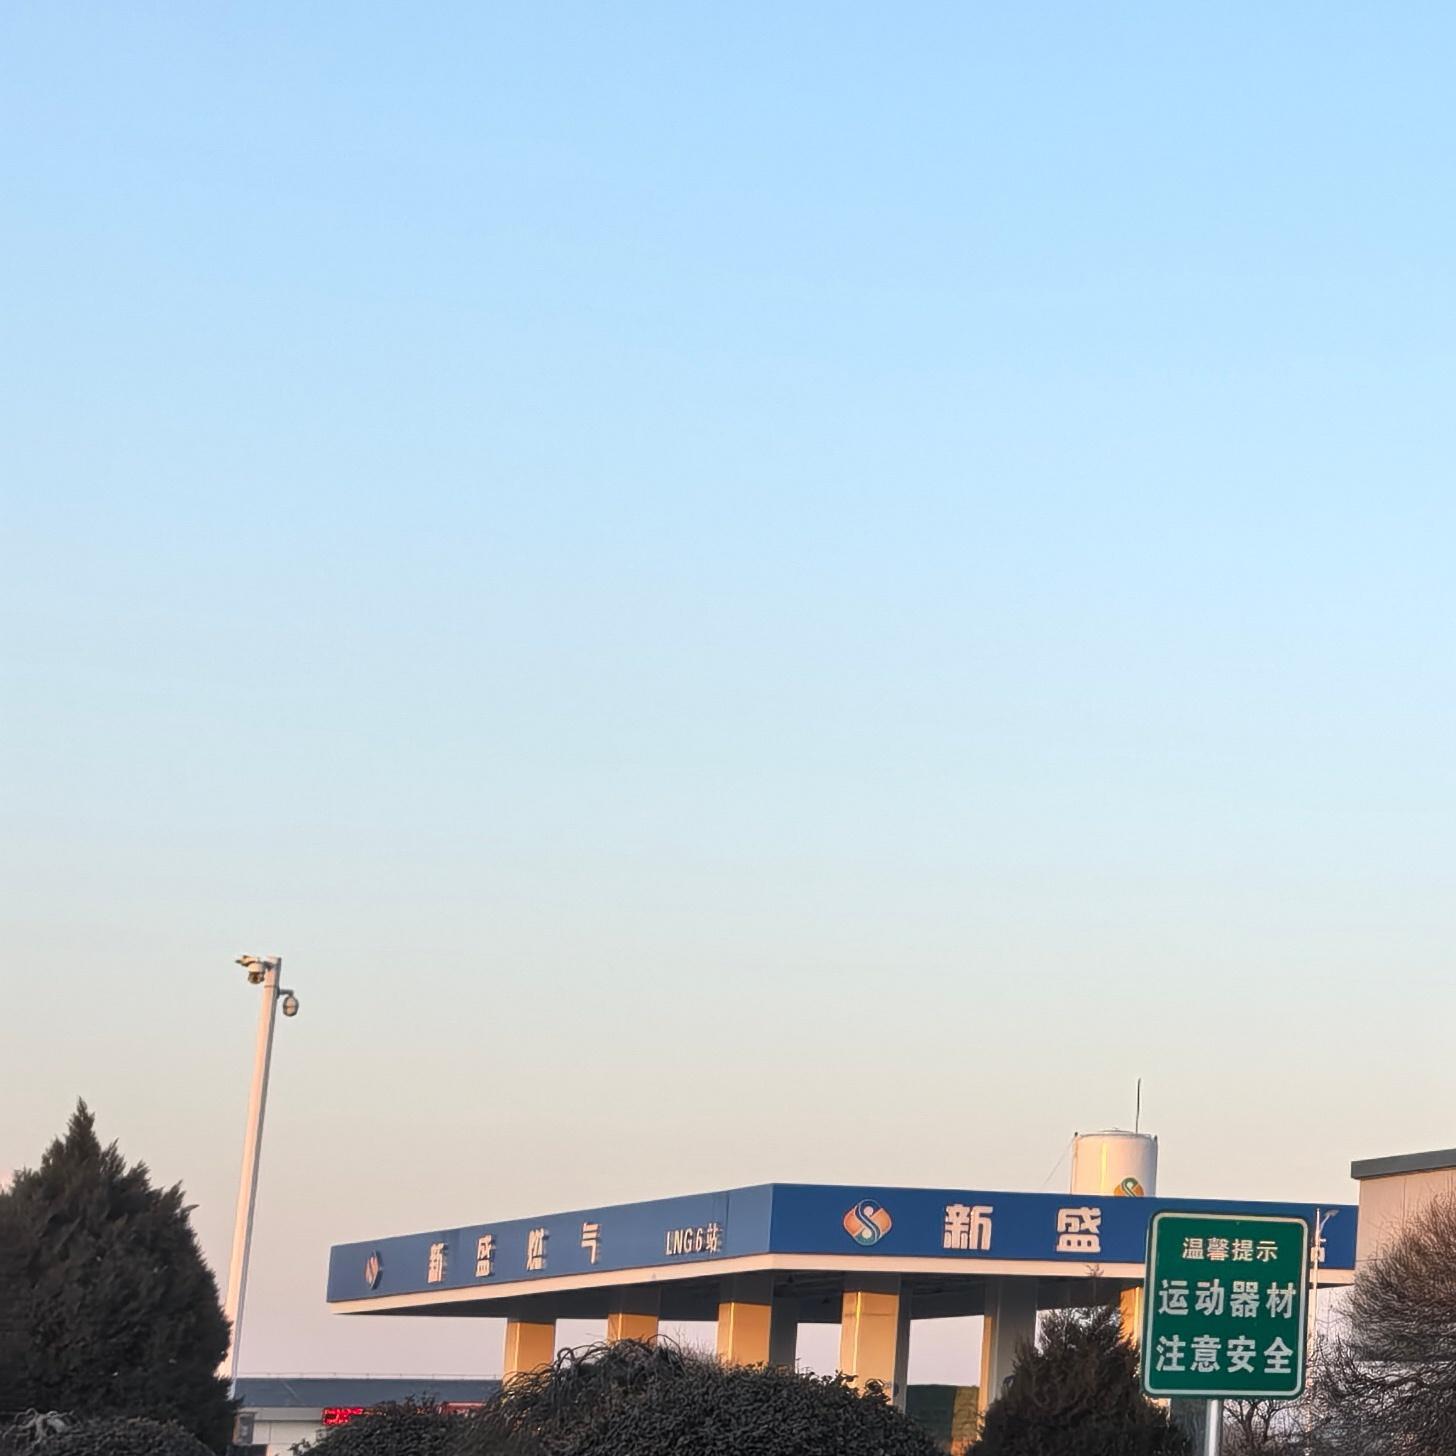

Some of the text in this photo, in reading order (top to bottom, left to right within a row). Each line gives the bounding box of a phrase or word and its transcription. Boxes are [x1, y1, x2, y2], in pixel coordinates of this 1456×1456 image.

[1182, 1237, 1278, 1262] 温馨提示
[1158, 1278, 1296, 1319] 运动器材
[1155, 1334, 1293, 1374] 注意安全
